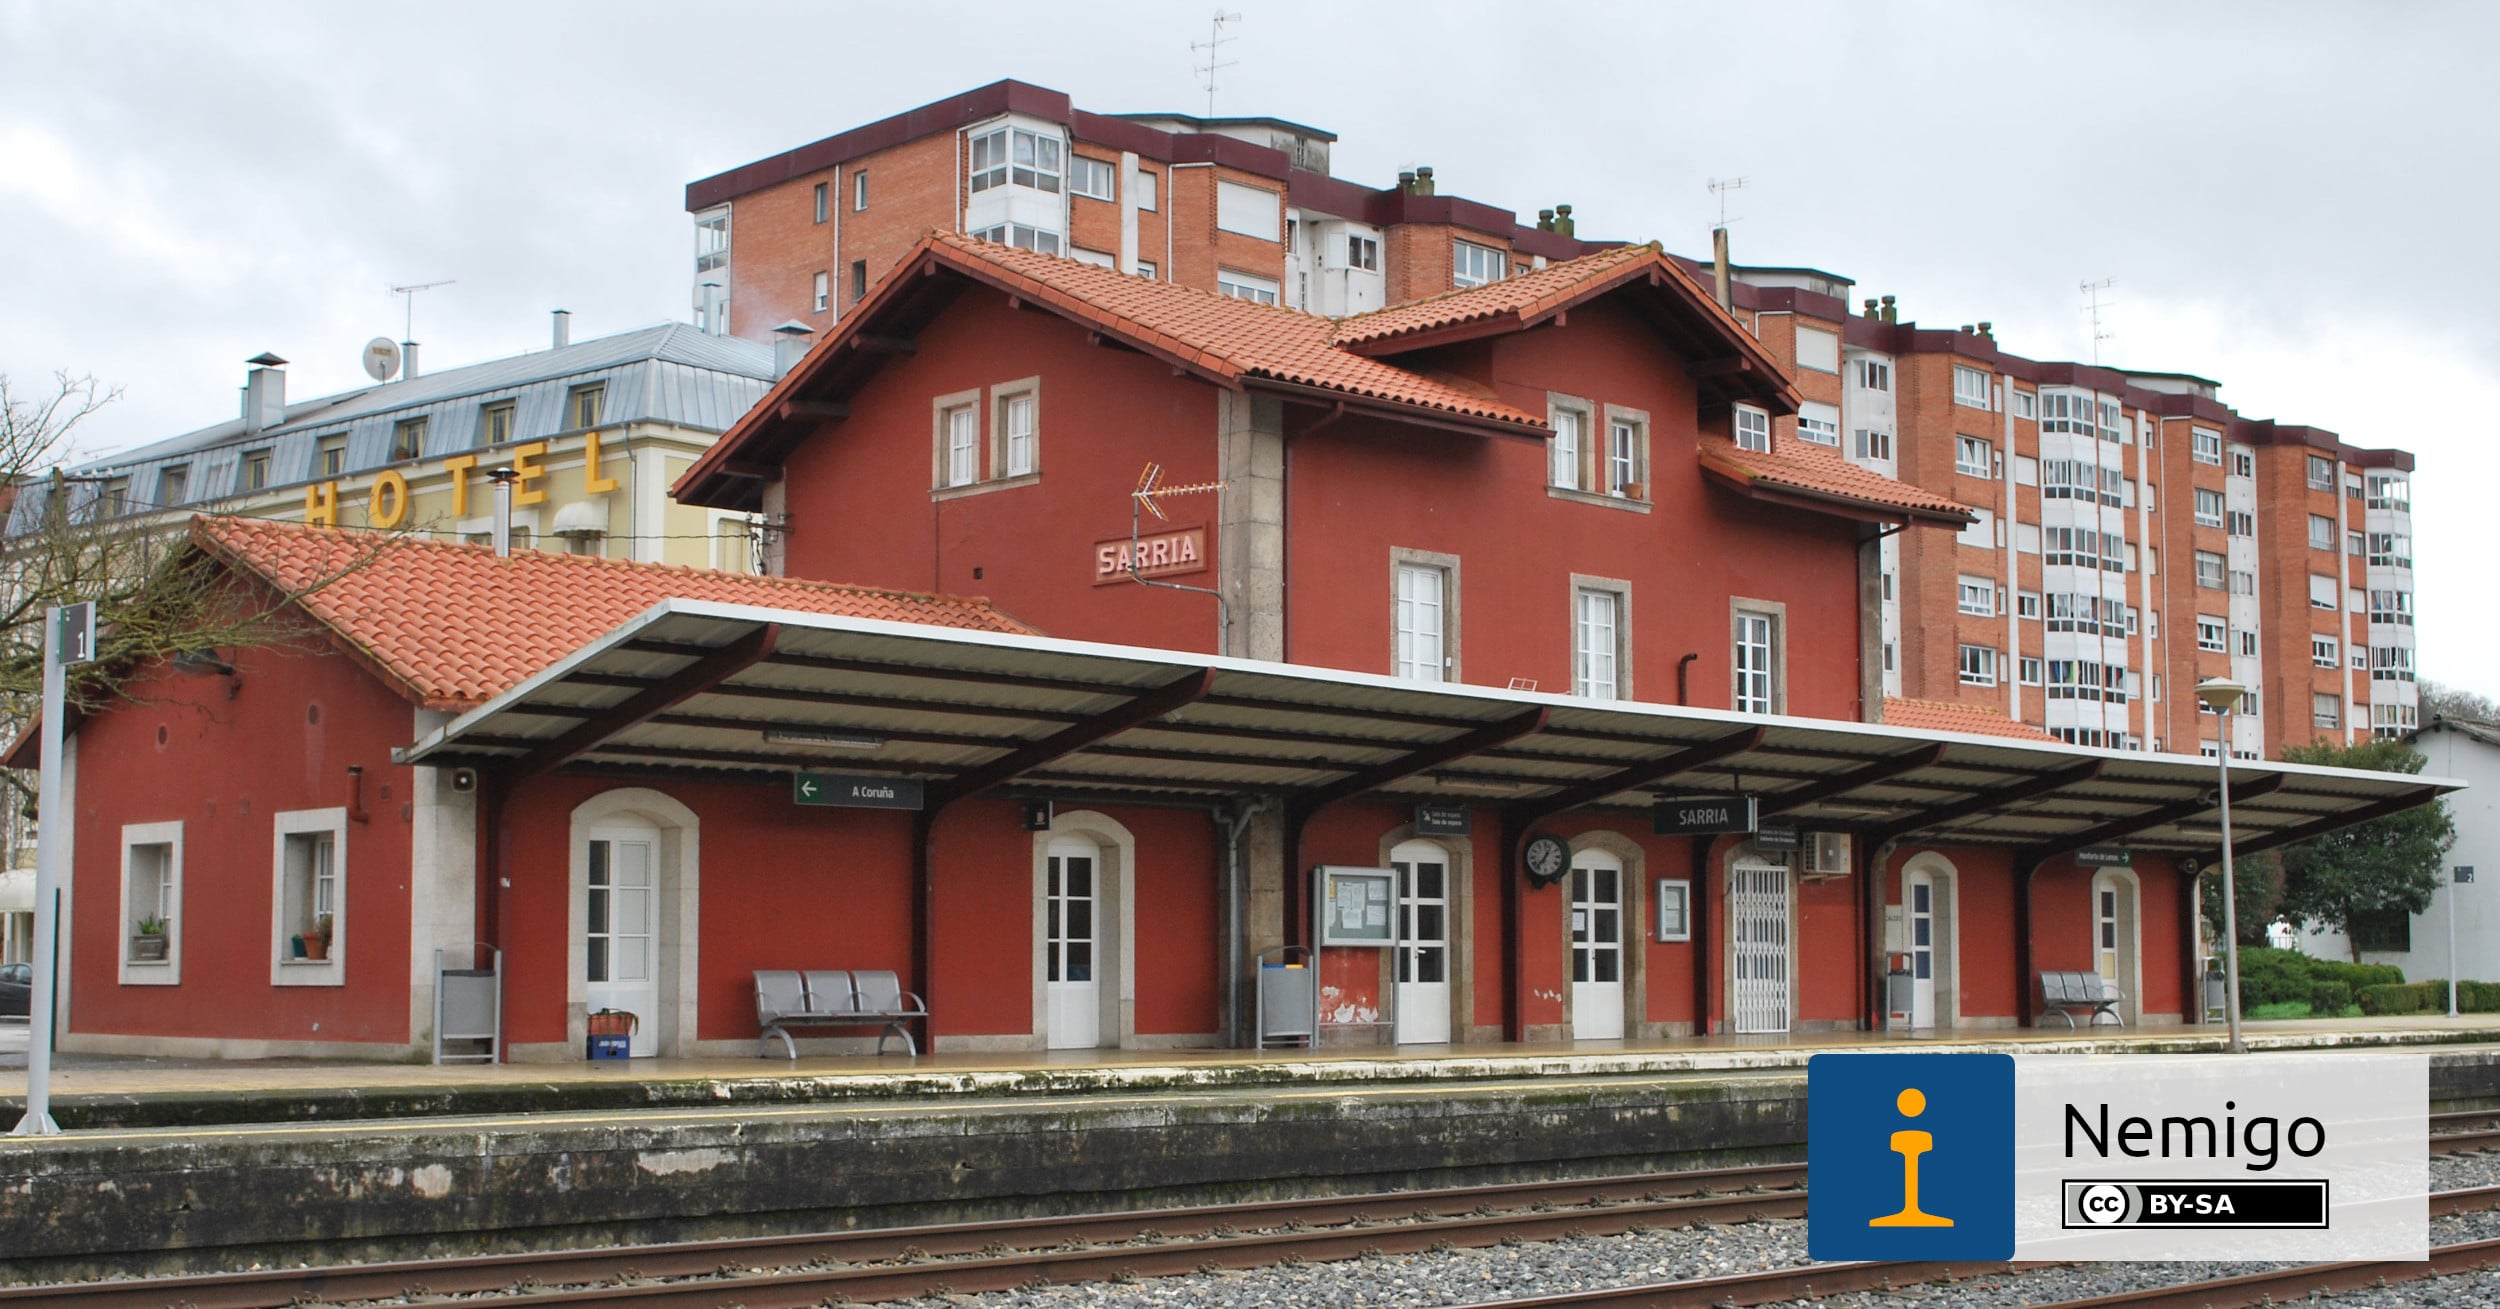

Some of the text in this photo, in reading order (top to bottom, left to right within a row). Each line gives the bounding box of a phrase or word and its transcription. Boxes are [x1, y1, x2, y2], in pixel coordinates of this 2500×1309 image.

[305, 431, 618, 529] HOTEL
[1099, 535, 1198, 574] SARRIA
[77, 631, 85, 659] 1
[852, 786, 894, 799] A Coruña
[1679, 808, 1729, 826] SARRIA
[2466, 873, 2473, 883] 2
